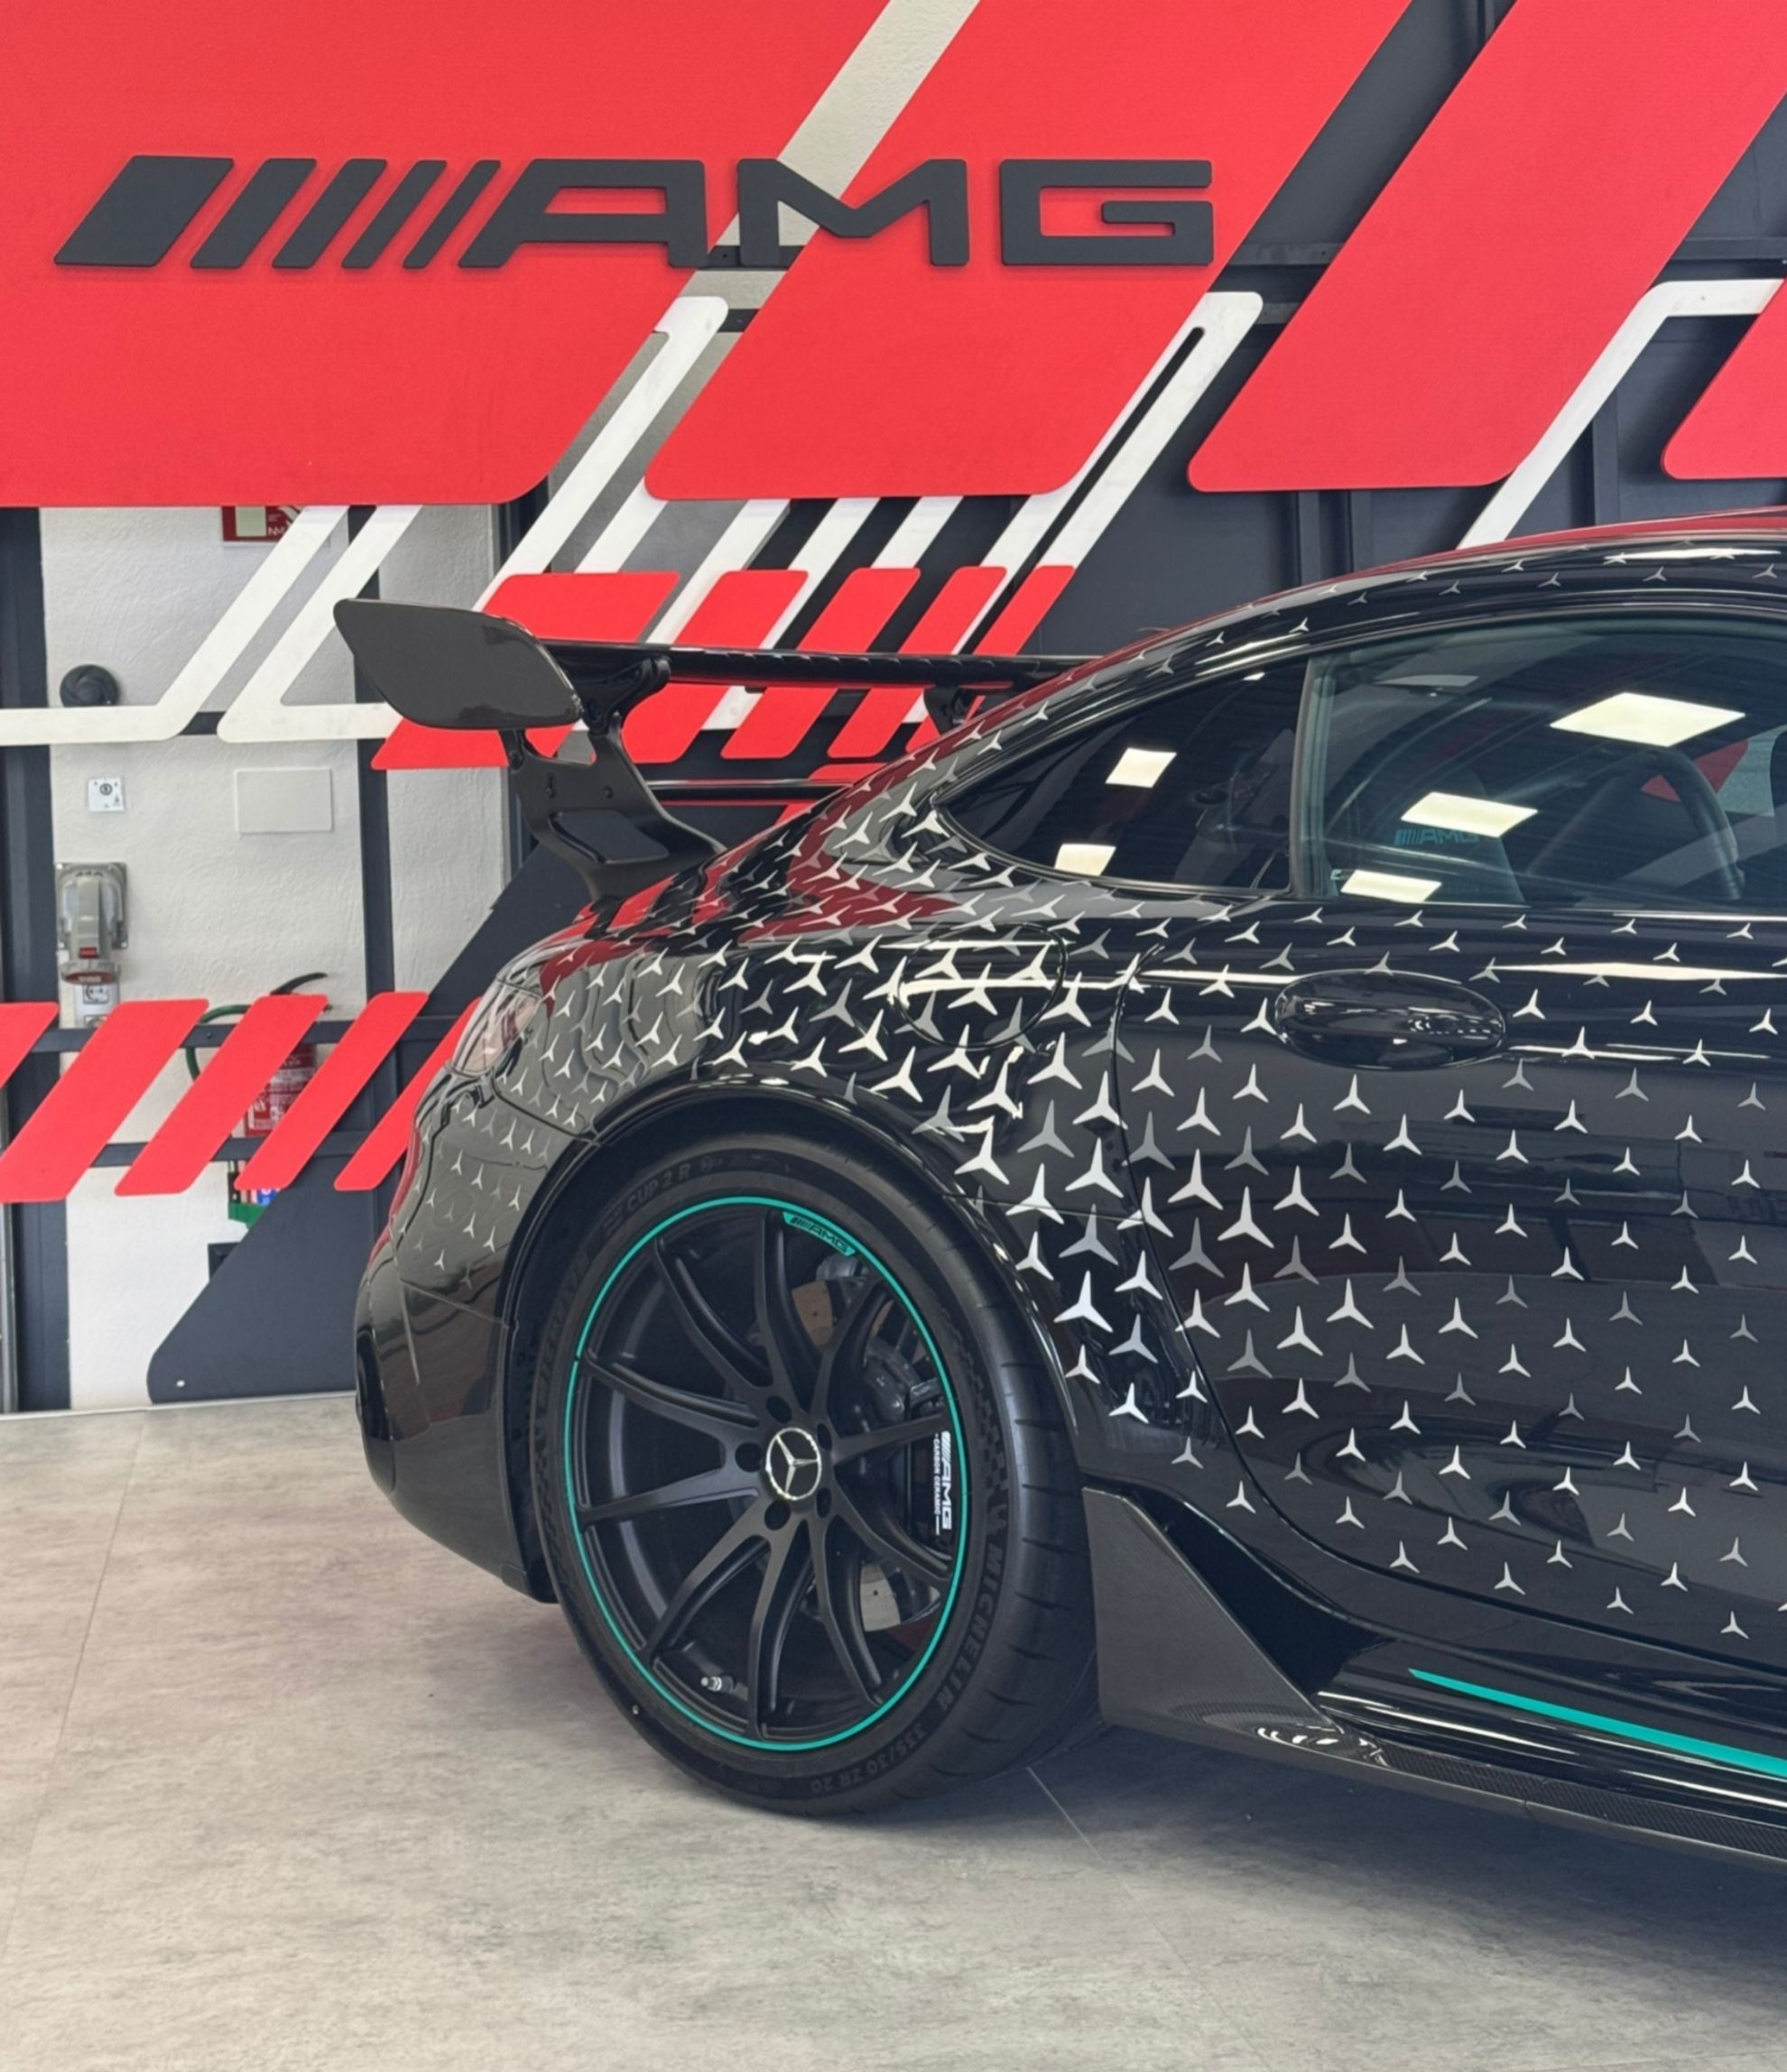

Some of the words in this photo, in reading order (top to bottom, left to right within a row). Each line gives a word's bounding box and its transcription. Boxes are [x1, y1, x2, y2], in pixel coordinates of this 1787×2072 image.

[458, 157, 1215, 268] AMG
[627, 1179, 659, 1210] CUP
[662, 1170, 673, 1186] 2
[679, 1163, 691, 1181] R
[809, 1223, 847, 1253] AMG
[941, 1457, 952, 1530] AMG
[937, 1542, 1004, 1711] MICHELIN
[867, 1722, 927, 1775] 335/30
[812, 1777, 834, 1794] 20
[839, 1767, 865, 1787] ZR
